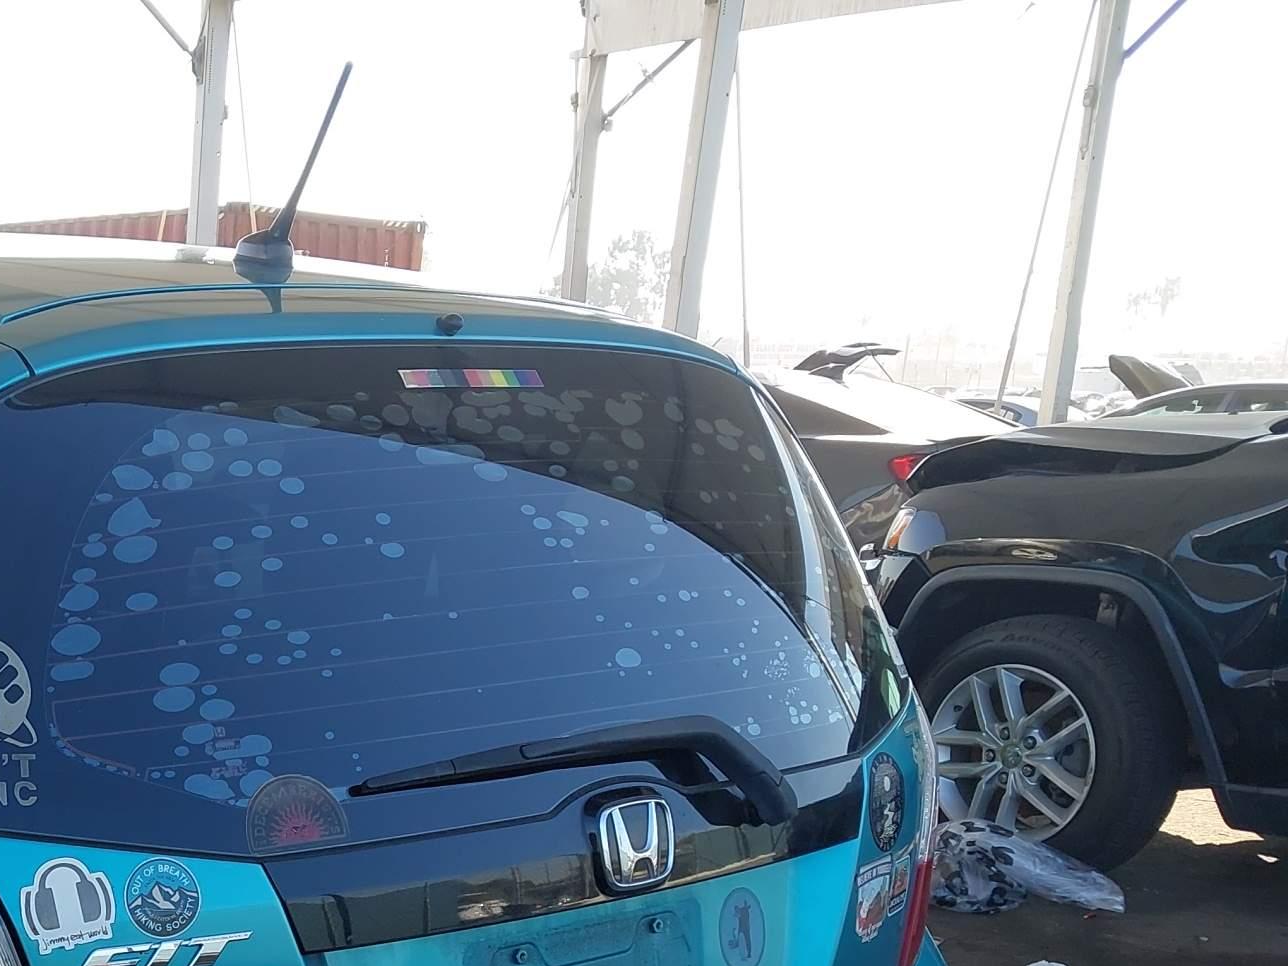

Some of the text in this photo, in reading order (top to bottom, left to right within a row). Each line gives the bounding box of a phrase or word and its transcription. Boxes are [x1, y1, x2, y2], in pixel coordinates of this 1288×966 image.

[131, 875, 143, 895] OUT
[143, 865, 155, 877] OF
[158, 864, 191, 887] BREATH
[134, 907, 163, 932] HIKING
[166, 897, 195, 932] SOCIETY
